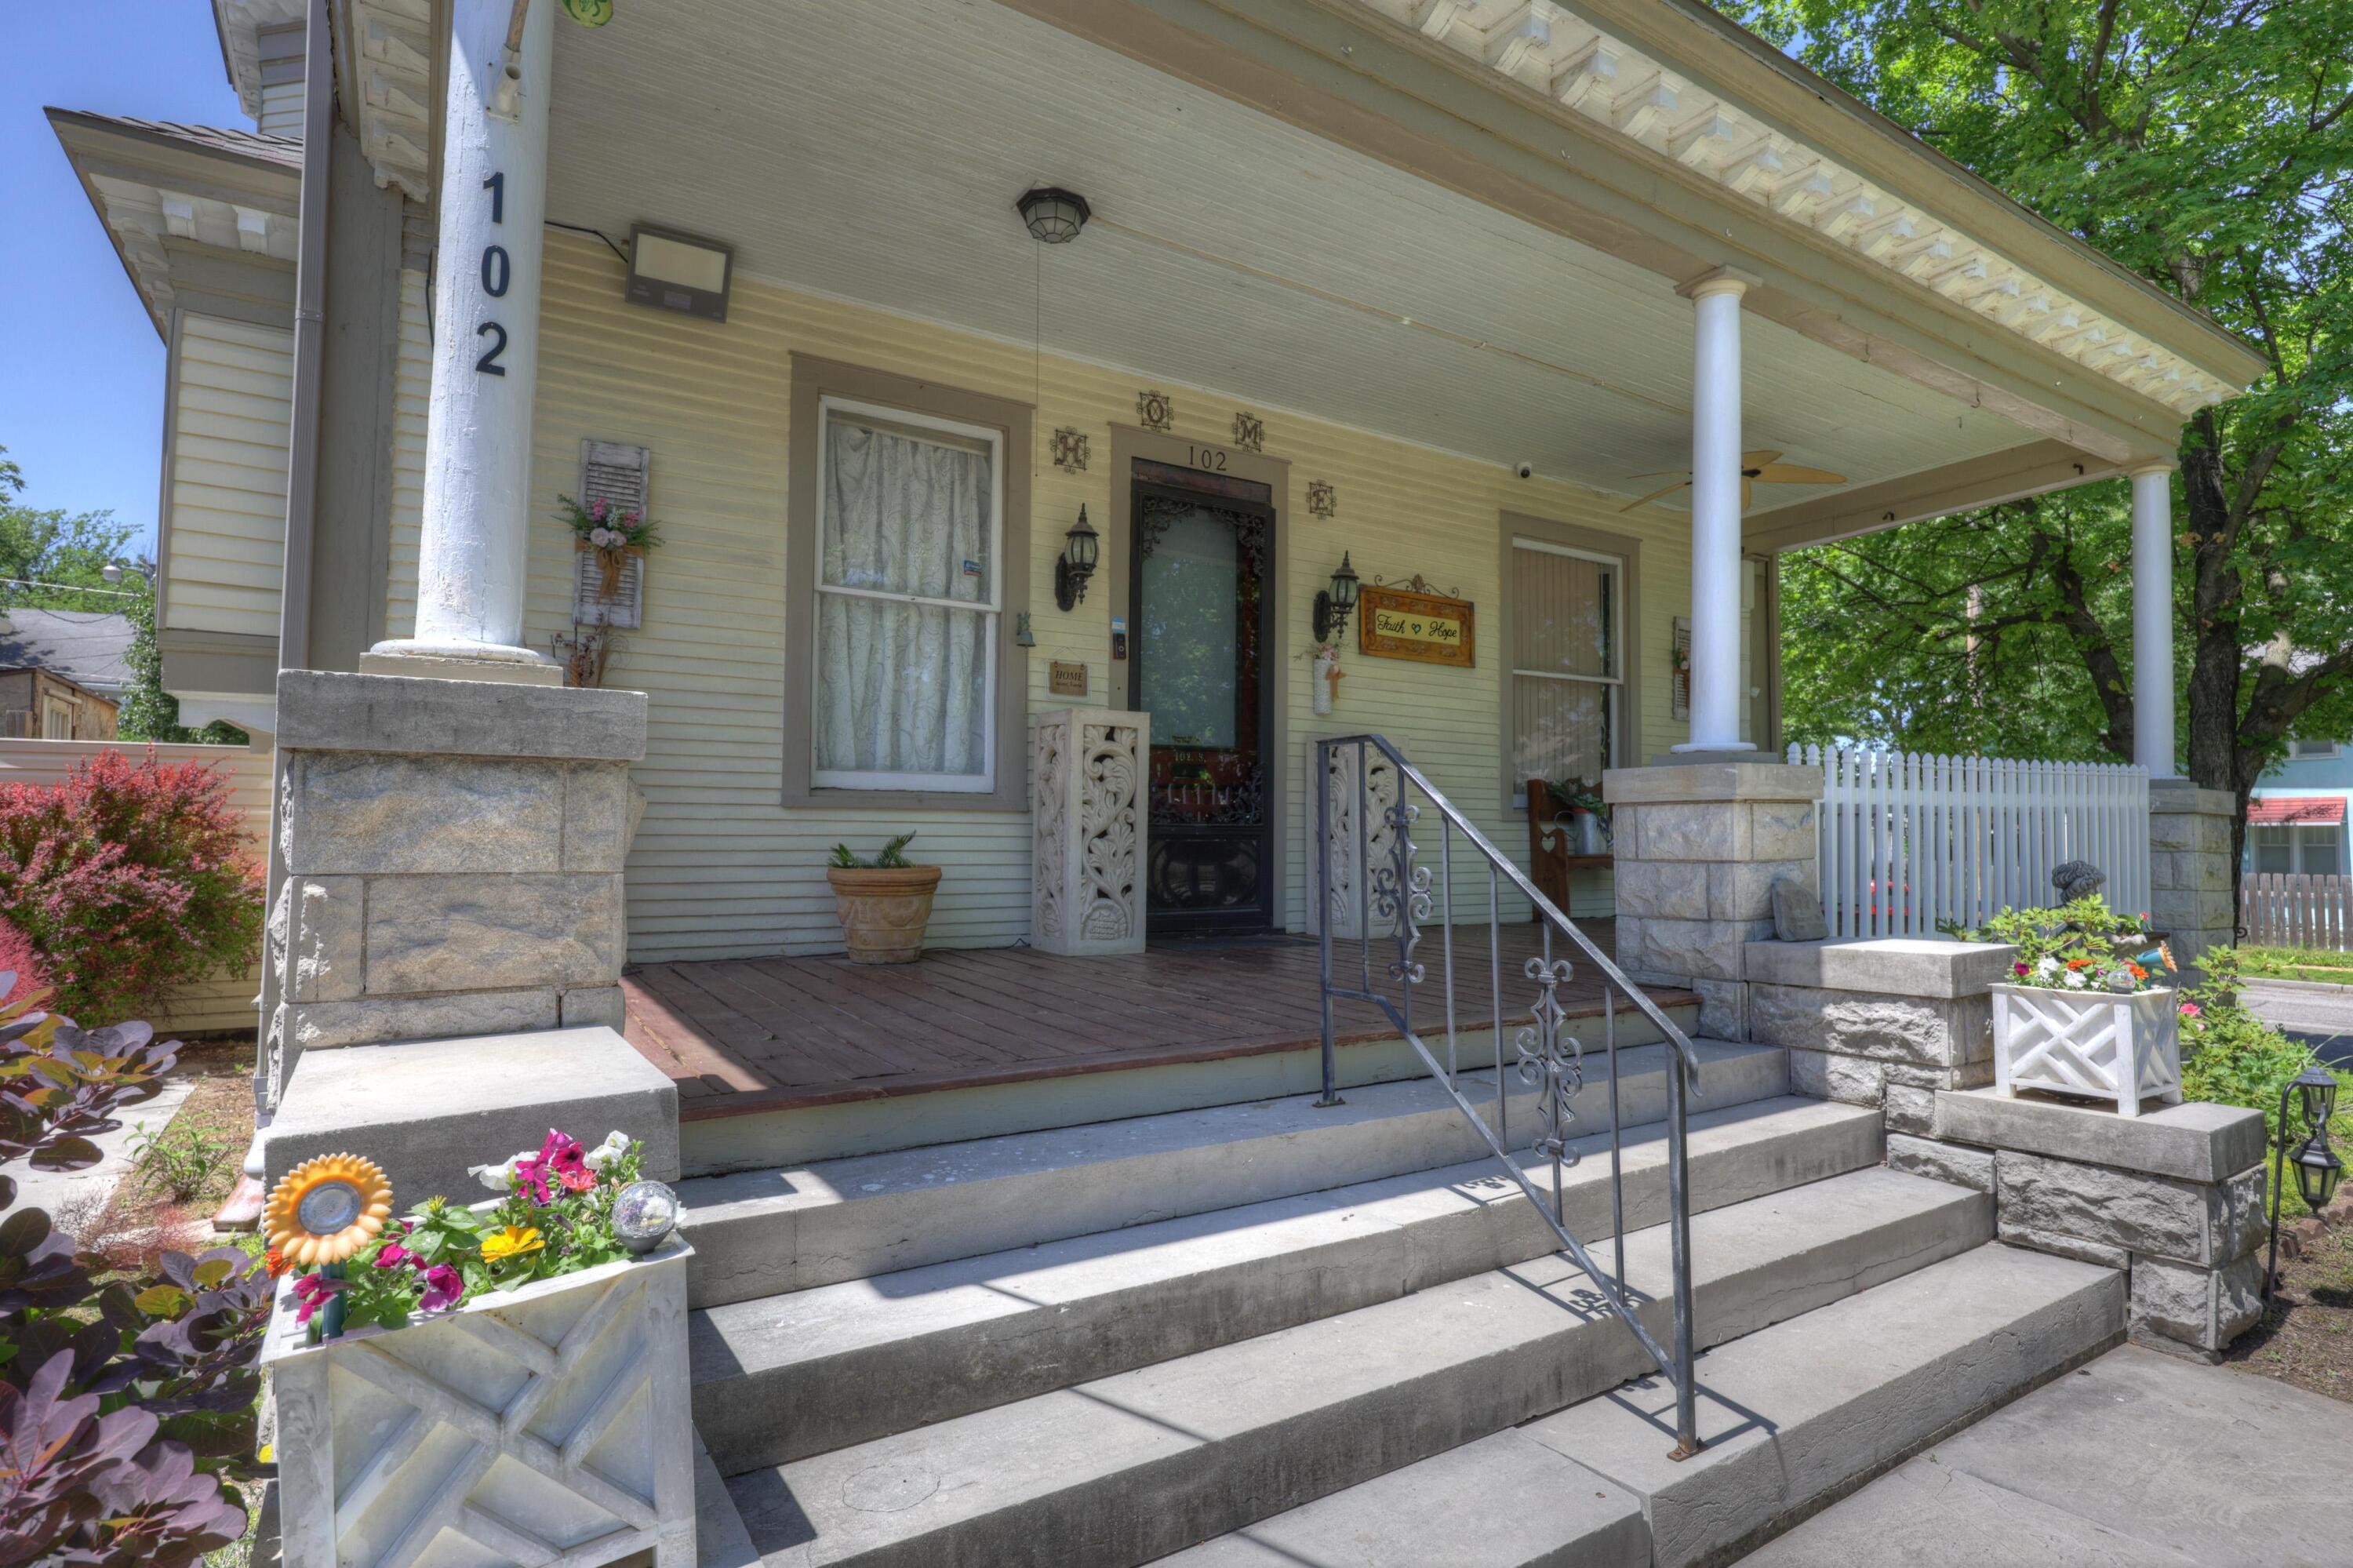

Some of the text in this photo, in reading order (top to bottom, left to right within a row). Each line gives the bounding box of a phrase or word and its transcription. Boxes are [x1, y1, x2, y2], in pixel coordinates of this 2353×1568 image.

[475, 172, 510, 377] 102
[1189, 446, 1227, 471] 102
[1377, 614, 1457, 641] Faith Hope
[1055, 671, 1084, 682] HOME
